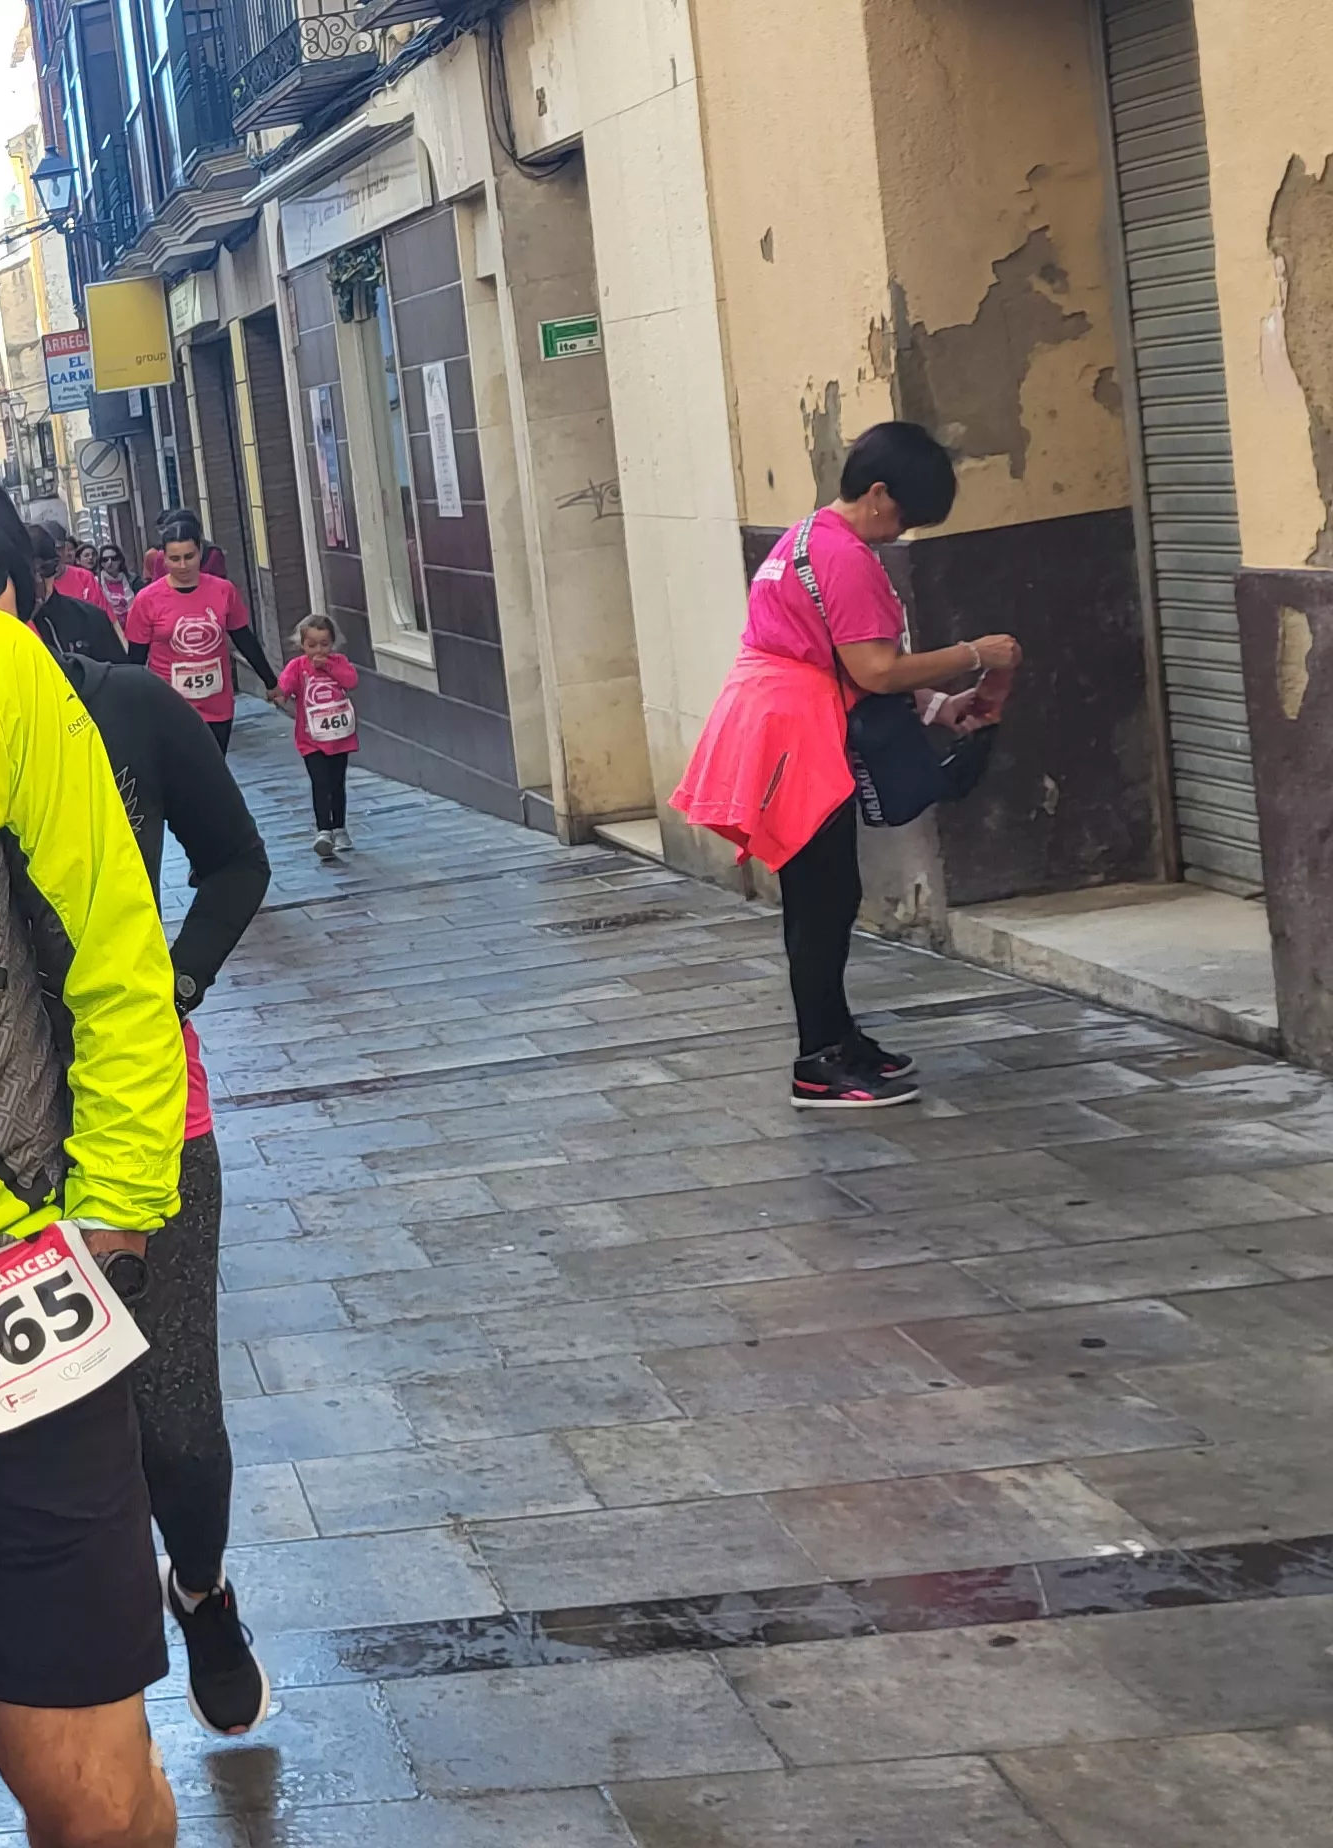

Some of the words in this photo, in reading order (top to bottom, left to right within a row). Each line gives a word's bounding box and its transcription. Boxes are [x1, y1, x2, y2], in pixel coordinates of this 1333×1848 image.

[68, 355, 86, 369] EL
[135, 351, 167, 366] group
[183, 673, 215, 690] 459
[320, 713, 349, 731] 460
